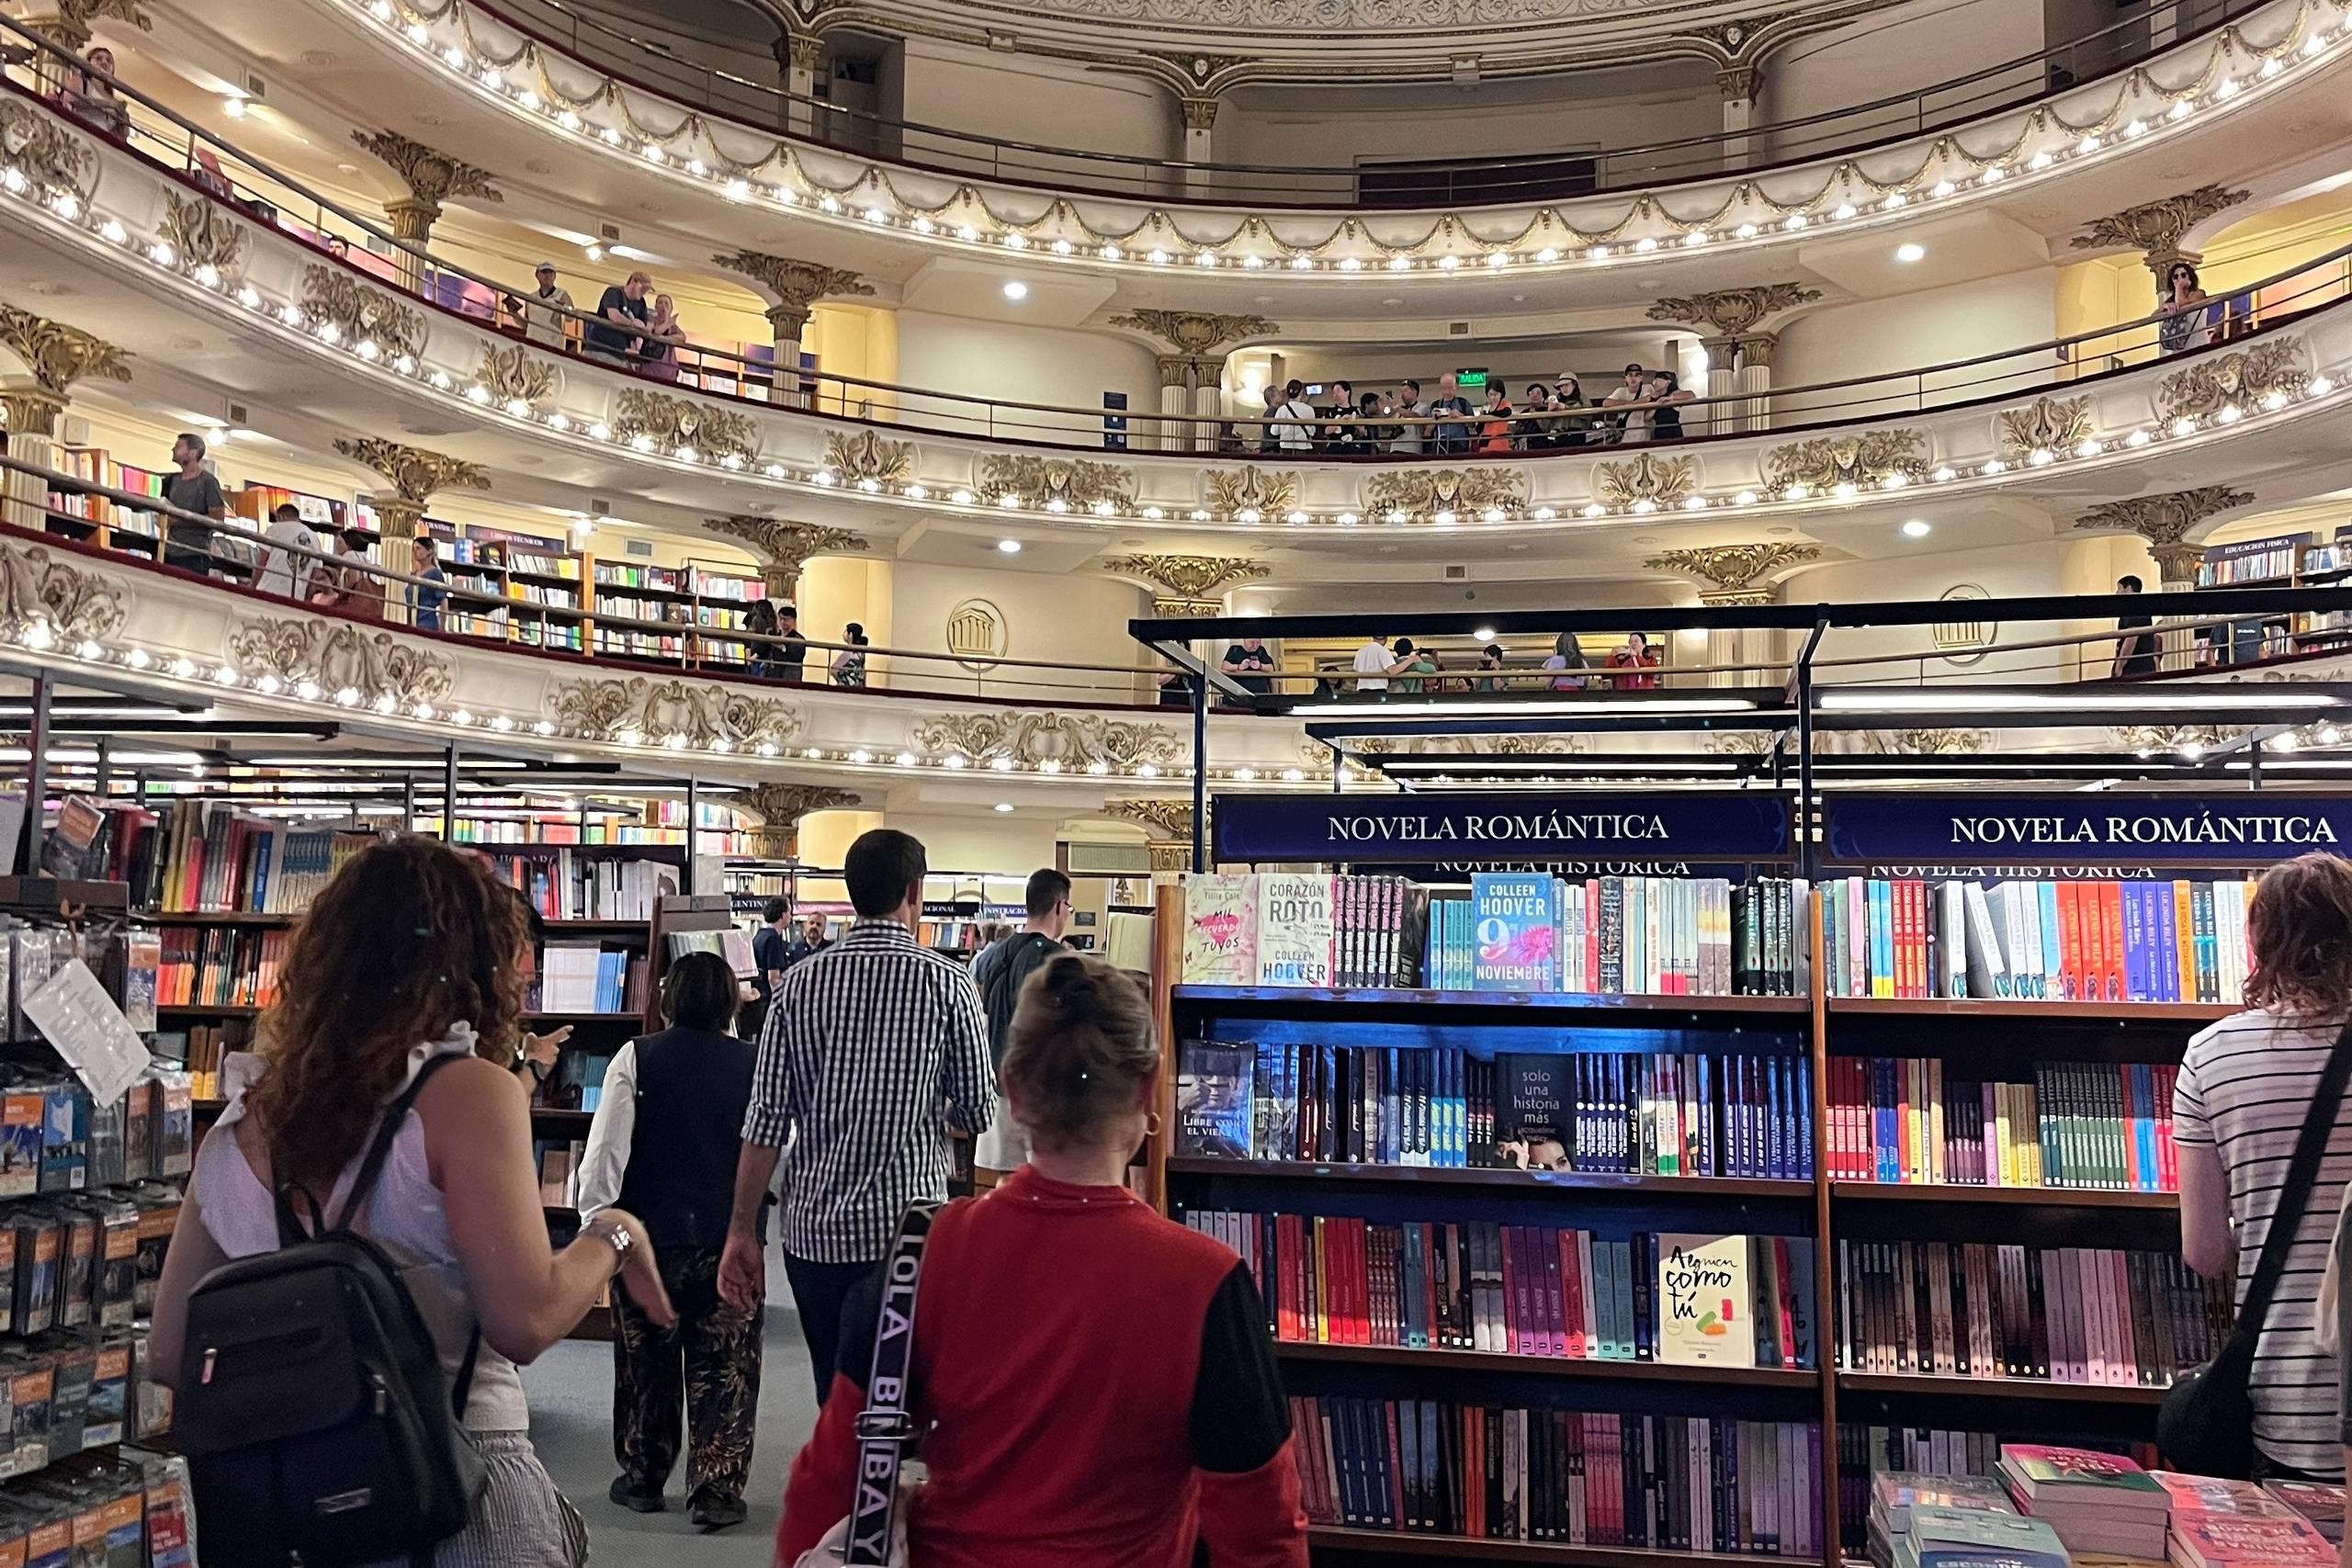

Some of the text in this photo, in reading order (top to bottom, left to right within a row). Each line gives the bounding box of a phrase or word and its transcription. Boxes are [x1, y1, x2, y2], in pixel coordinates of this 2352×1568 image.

[1329, 808, 1668, 840] NOVELA ROMÁNTICA
[1951, 810, 2338, 843] NOVELA ROMÁNTICA
[1270, 884, 1324, 897] CORAZÓN
[1489, 885, 1536, 897] COLLEEN
[1214, 908, 1232, 919] MIL
[1270, 900, 1323, 922] ROTO
[1480, 897, 1546, 916] HOOVER
[2145, 891, 2154, 926] LUCINDA
[2161, 891, 2170, 926] LUCINDA
[1202, 937, 1239, 954] TUYOS
[1477, 918, 1510, 960] 9
[2146, 927, 2155, 947] RILEY
[1275, 950, 1315, 961] COLLEEN
[1476, 965, 1550, 980] NOVIEMBRE
[1522, 1069, 1550, 1082] solo
[1525, 1086, 1548, 1096] una
[1524, 1111, 1550, 1123] más
[1187, 1127, 1199, 1135] EL
[881, 1234, 924, 1342] LOLA
[1666, 1270, 1732, 1288] como
[1668, 1286, 1698, 1319] tú
